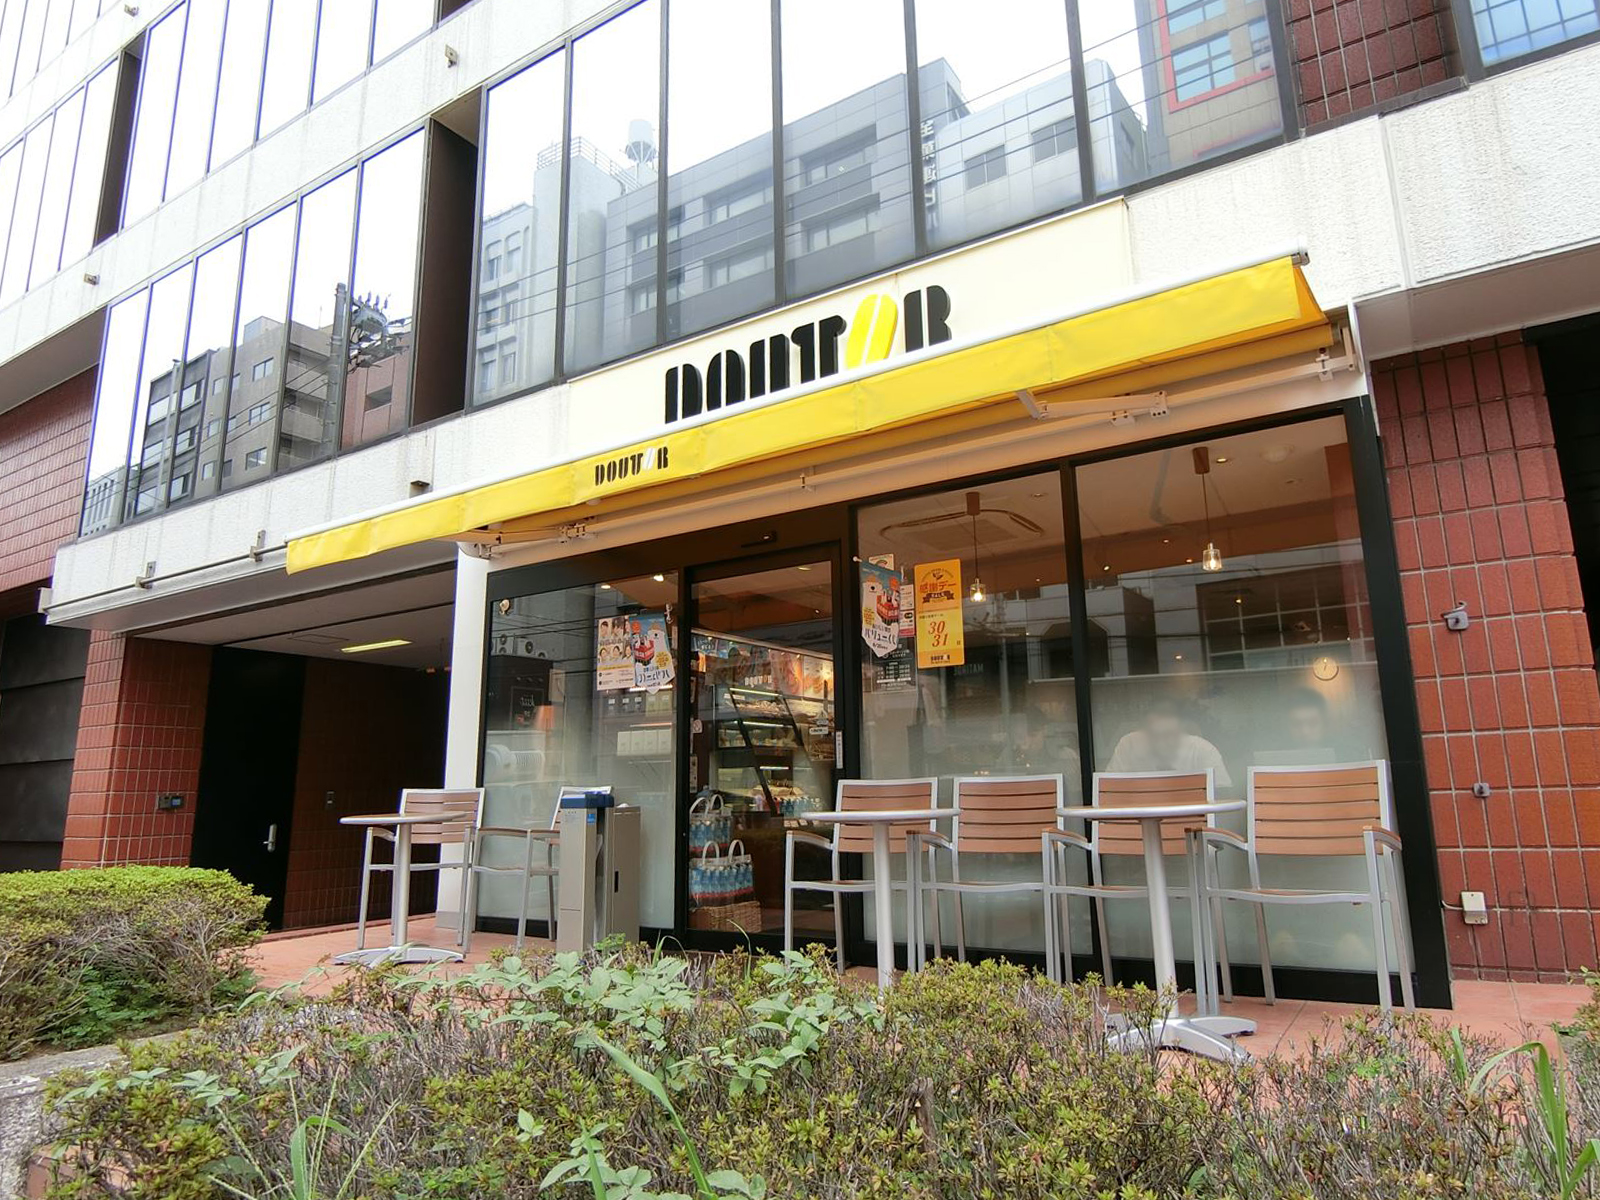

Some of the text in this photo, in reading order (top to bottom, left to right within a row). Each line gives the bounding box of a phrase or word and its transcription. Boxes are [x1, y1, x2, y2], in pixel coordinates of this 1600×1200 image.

[665, 285, 952, 424] DOUTOR
[594, 446, 669, 486] DOUTOR
[928, 620, 946, 635] 30
[932, 634, 949, 648] 31
